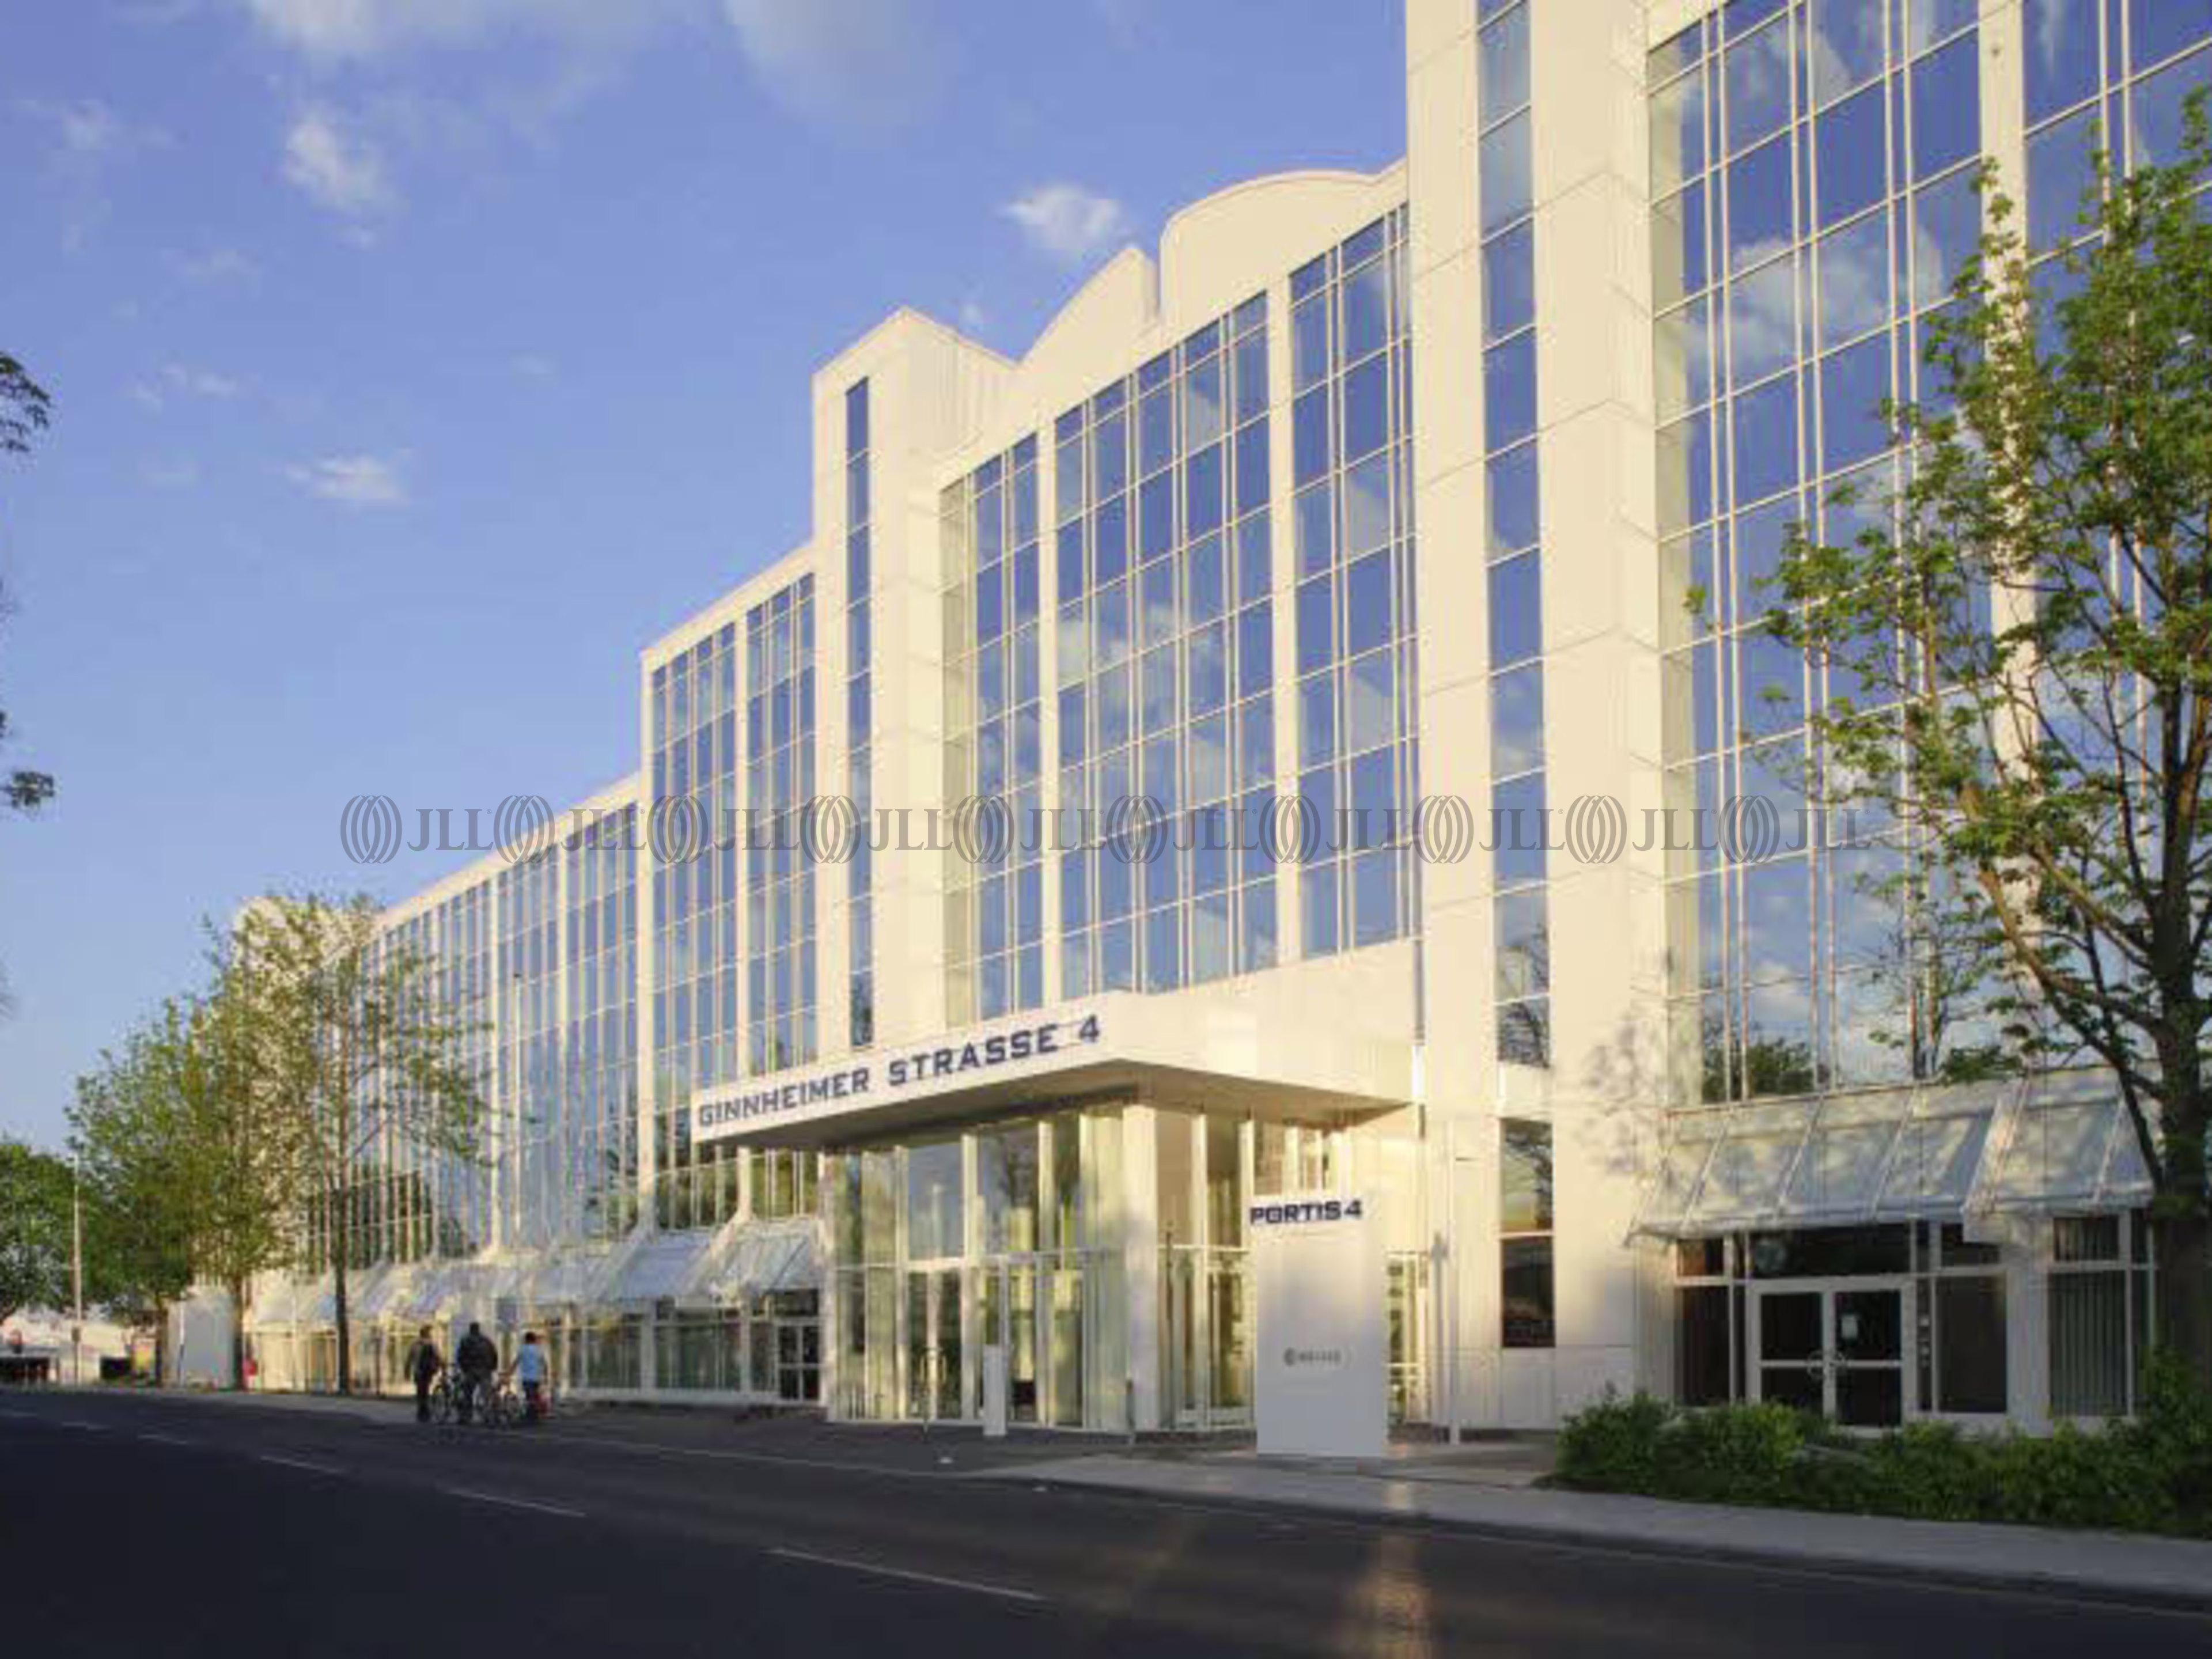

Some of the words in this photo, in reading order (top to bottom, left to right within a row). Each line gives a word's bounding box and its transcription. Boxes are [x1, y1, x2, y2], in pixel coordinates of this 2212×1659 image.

[699, 1067, 870, 1127] GINNHEIMER
[888, 1024, 1059, 1086] STRASSE
[1078, 1014, 1100, 1043] 4
